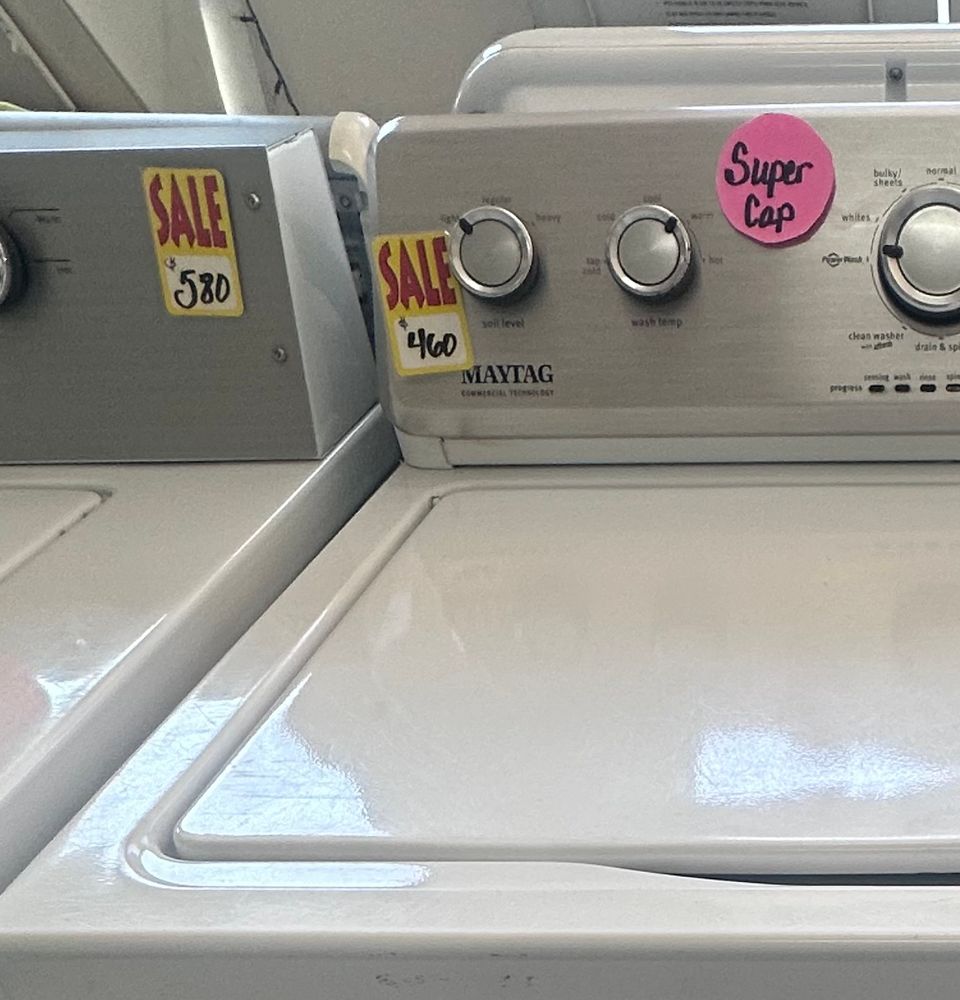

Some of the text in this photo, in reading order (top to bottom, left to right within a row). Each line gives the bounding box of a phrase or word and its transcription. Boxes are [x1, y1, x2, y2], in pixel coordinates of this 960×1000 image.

[724, 141, 814, 198] Super
[873, 168, 902, 179] bulky/
[926, 167, 957, 175] normal
[873, 177, 903, 187] sheets
[150, 173, 228, 248] SALE
[744, 193, 796, 233] Cap
[841, 213, 871, 222] whites
[378, 236, 457, 311] SALE
[482, 317, 525, 329] soil level
[631, 317, 683, 329] wash temp
[848, 331, 905, 341] clean washer
[915, 342, 937, 351] drain
[939, 342, 946, 351] &
[461, 364, 555, 385] MAYTAG
[830, 384, 863, 393] progress
